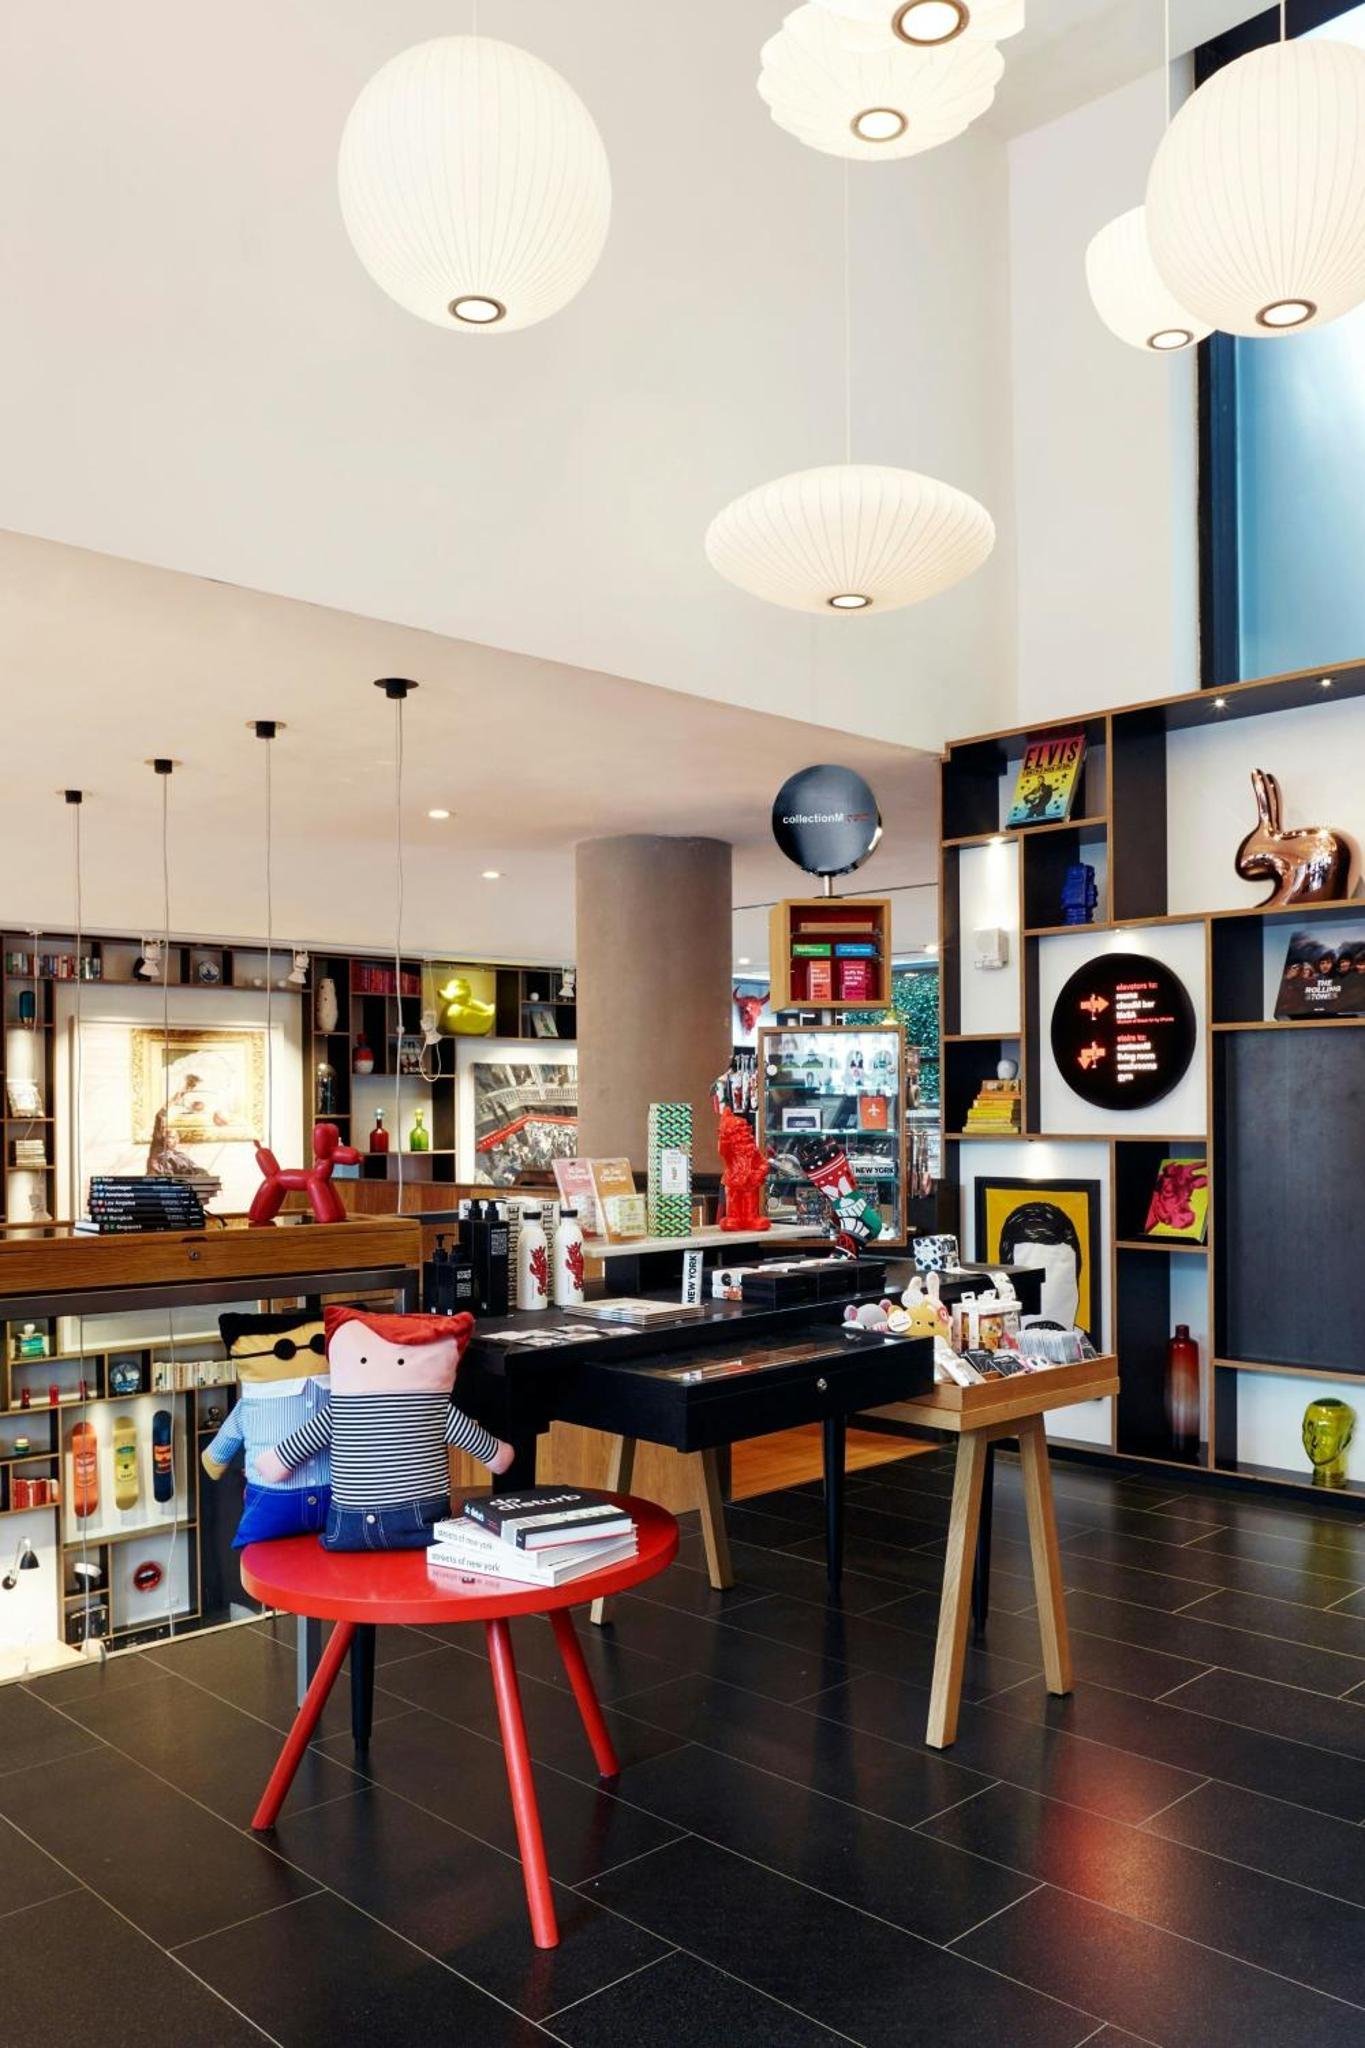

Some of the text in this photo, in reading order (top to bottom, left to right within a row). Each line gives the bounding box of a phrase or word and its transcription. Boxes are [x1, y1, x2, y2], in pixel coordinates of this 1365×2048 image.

[1023, 741, 1079, 771] ELVIS
[782, 812, 844, 824] collectionM
[1317, 979, 1333, 987] THE
[1305, 985, 1342, 994] ROLLING
[856, 1166, 895, 1174] NEW YORK
[687, 1255, 697, 1303] NEW YORK
[489, 1497, 521, 1507] do
[497, 1493, 582, 1511] disturb
[458, 1556, 466, 1566] of
[467, 1560, 482, 1569] new
[484, 1562, 501, 1573] york
